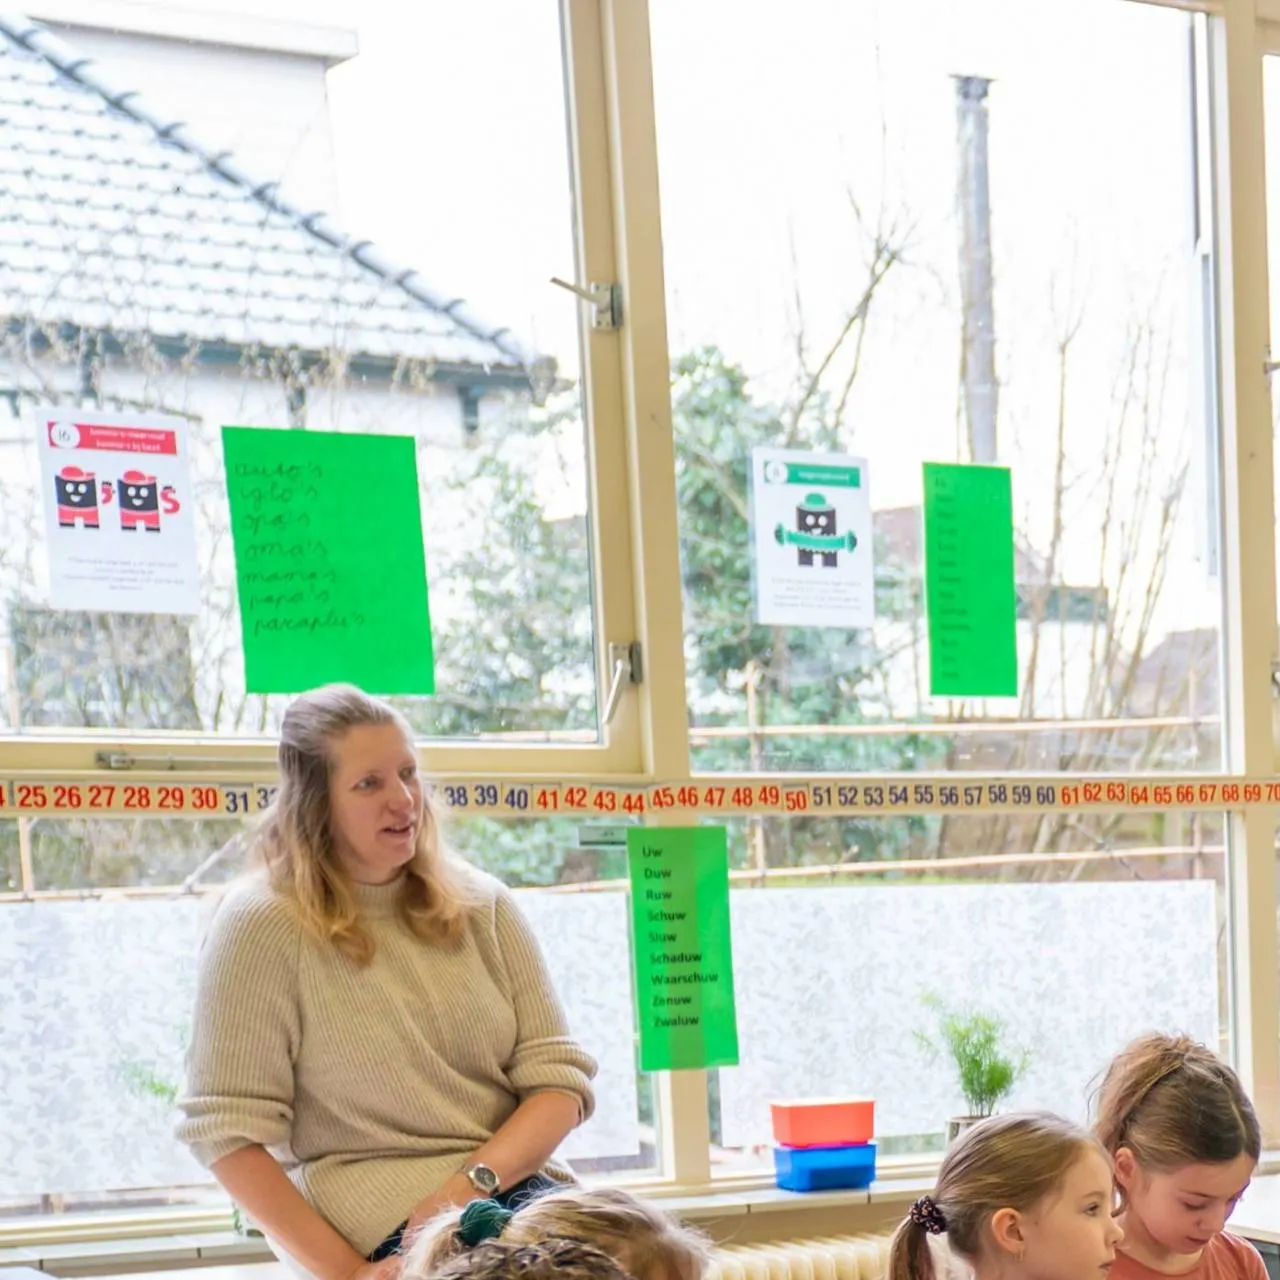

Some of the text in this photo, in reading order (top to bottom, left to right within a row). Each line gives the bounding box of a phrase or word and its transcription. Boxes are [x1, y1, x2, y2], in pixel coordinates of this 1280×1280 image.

[18, 785, 47, 808] 25
[53, 785, 82, 808] 26
[88, 785, 116, 808] 27
[123, 786, 151, 808] 28
[157, 785, 184, 809] 29
[192, 786, 218, 809] 30
[225, 790, 249, 813] 31
[474, 784, 498, 806] 39
[504, 788, 529, 810] 40
[537, 789, 558, 809] 41
[564, 786, 587, 808] 42
[593, 789, 616, 811] 43
[622, 792, 644, 814] 44
[652, 787, 674, 808] 45
[677, 786, 698, 808] 46
[704, 786, 725, 808] 47
[732, 786, 753, 807] 48
[758, 785, 779, 806] 49
[786, 790, 807, 811] 50
[813, 786, 832, 806] 51
[838, 786, 858, 806] 52
[863, 786, 884, 806] 53
[888, 785, 908, 806] 54
[914, 784, 934, 804] 55
[939, 785, 959, 806] 56
[964, 786, 984, 806] 57
[988, 783, 1008, 803] 58
[1012, 784, 1031, 804] 59
[1036, 785, 1056, 805] 60
[1061, 786, 1080, 805] 61
[1083, 783, 1101, 801] 62
[1107, 782, 1125, 801] 63
[1130, 785, 1149, 804] 64
[1154, 784, 1172, 804] 65
[1176, 784, 1194, 804] 66
[1199, 784, 1217, 802] 67
[1222, 783, 1240, 803] 68
[1244, 783, 1261, 802] 69
[642, 846, 664, 858] Uw
[644, 868, 671, 879] Duw
[646, 889, 672, 900] Ruw
[647, 910, 686, 922] Schuw
[650, 952, 703, 964] Schaduw
[651, 972, 719, 985] Waarschuw
[654, 1015, 700, 1028] Zwaluw
